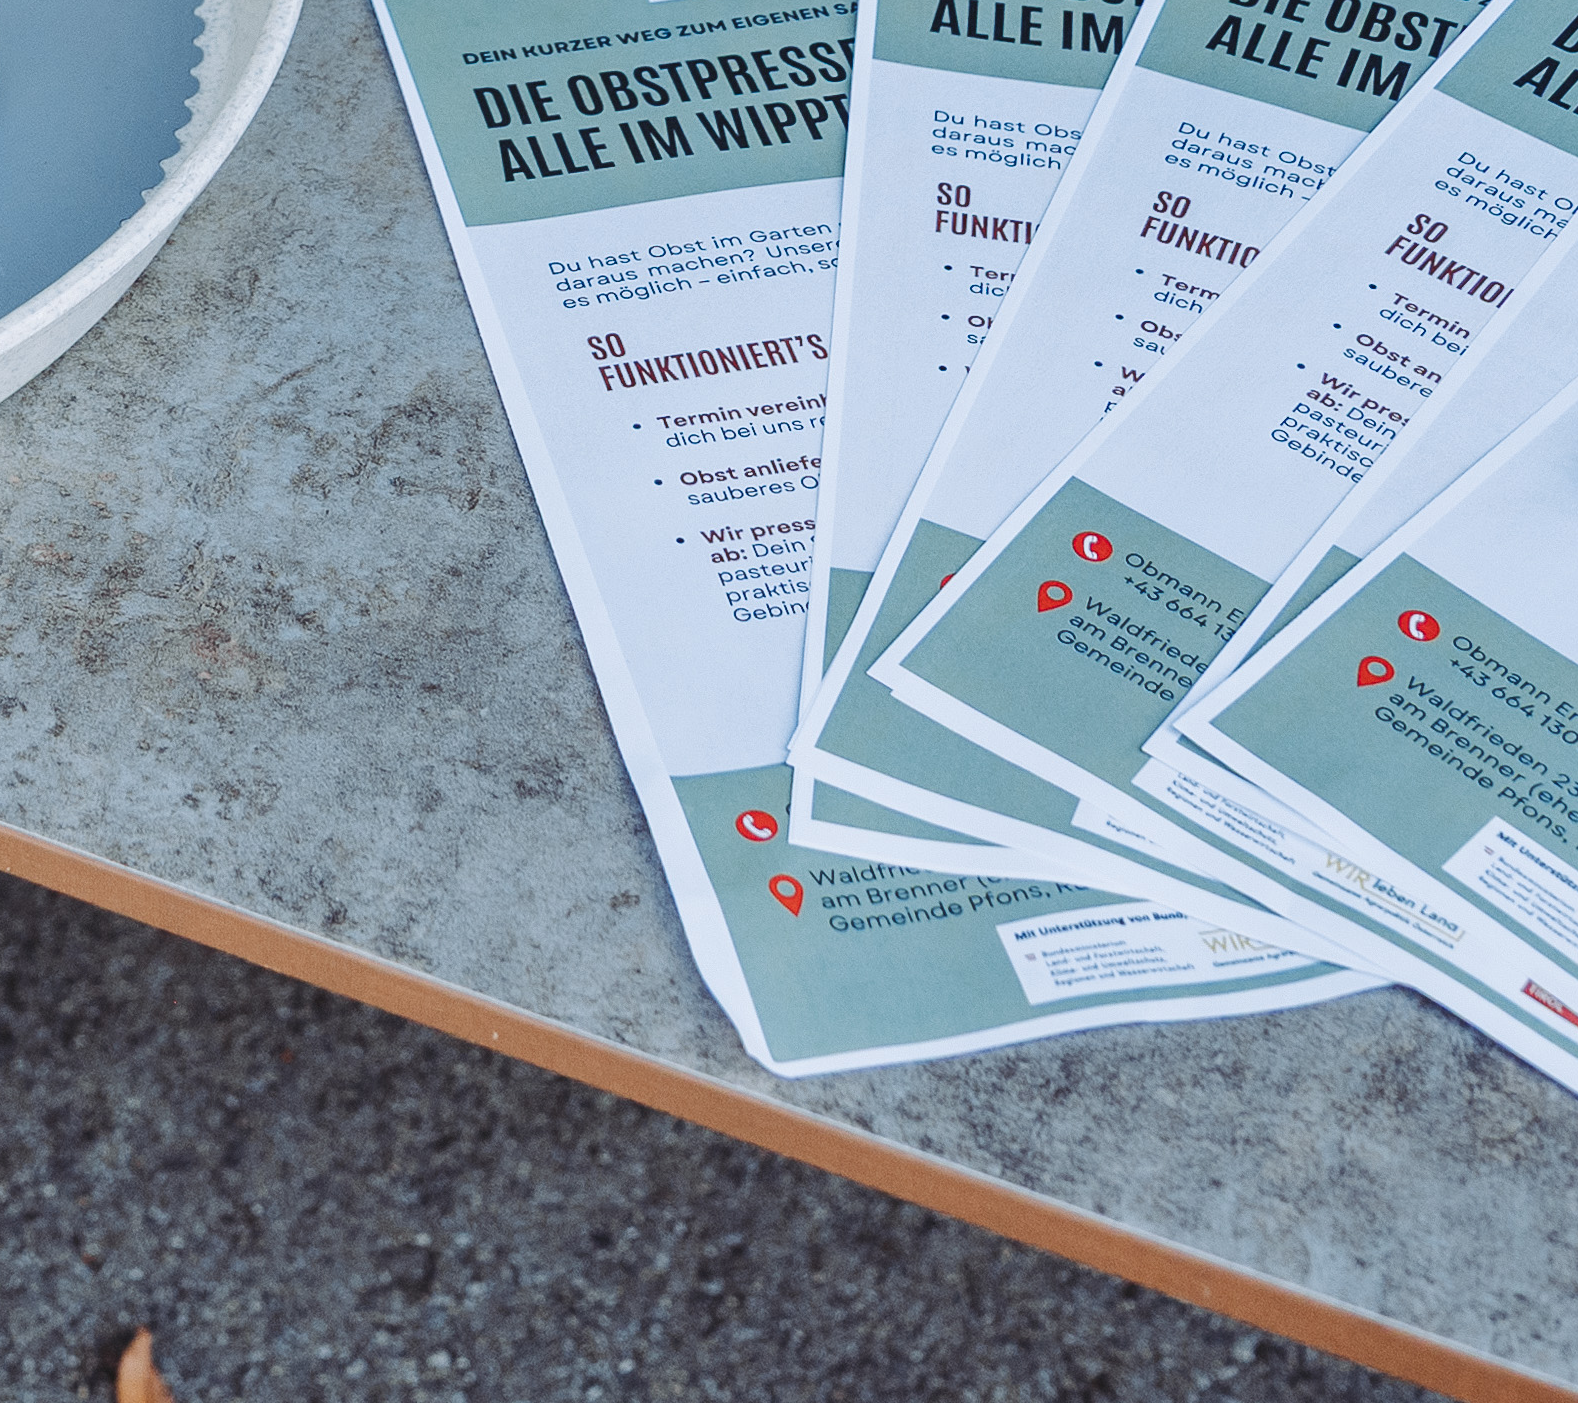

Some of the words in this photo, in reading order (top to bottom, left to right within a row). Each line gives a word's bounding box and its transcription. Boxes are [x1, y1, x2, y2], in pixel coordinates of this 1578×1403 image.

[461, 47, 518, 65] DEIN
[520, 34, 613, 58] KURZER
[614, 26, 673, 45] WEG
[674, 19, 728, 37] ZUM
[730, 5, 831, 30] EIGENEN
[1061, 9, 1124, 56] IM
[1204, 13, 1332, 80] ALLE
[1335, 46, 1412, 102] IM
[472, 79, 563, 129] DIE
[497, 125, 616, 183] ALLE
[617, 114, 695, 165] IM
[935, 181, 971, 208] SO
[1151, 189, 1192, 219] SO
[586, 331, 627, 361] SO
[597, 332, 829, 392] FUNKTIONIERT’S
[1123, 575, 1165, 602] +43
[1164, 598, 1208, 628] 664
[1124, 552, 1222, 614] Obmann
[1449, 658, 1492, 688] +43
[1490, 685, 1535, 718] 664
[1451, 635, 1552, 705] Obmann
[1387, 692, 1427, 722] am
[1429, 716, 1526, 783] Brenner
[1406, 675, 1549, 776] Waldfrieden
[1373, 705, 1494, 790] Gemeinde
[1496, 785, 1568, 844] Pfons,
[828, 899, 964, 933] Gemeinde
[967, 884, 1052, 912] Pfons,
